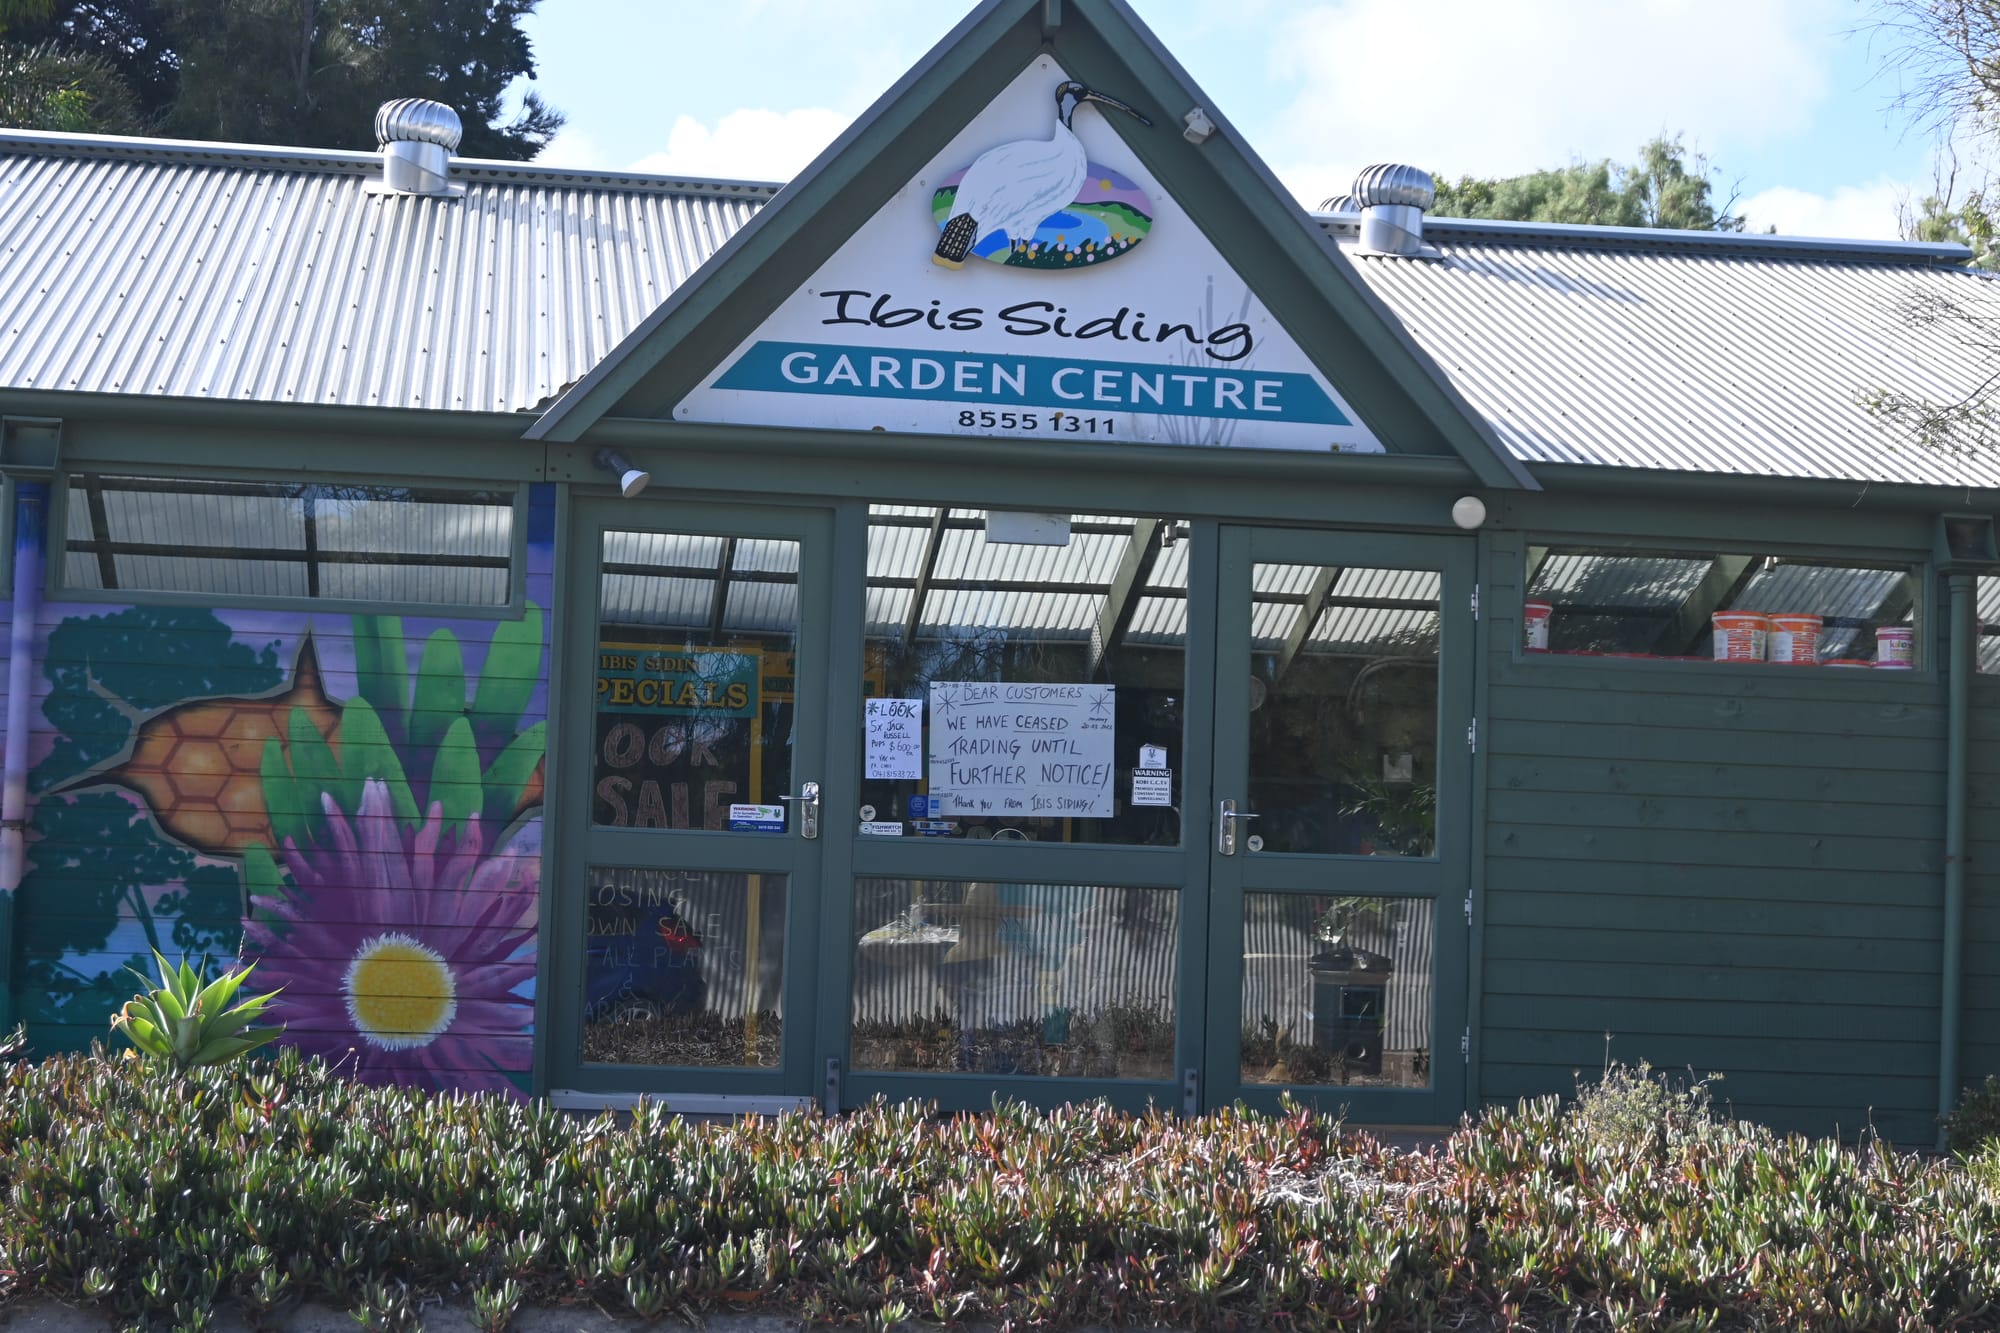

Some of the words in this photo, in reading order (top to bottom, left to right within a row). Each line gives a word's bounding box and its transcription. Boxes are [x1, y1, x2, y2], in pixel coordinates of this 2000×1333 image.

[819, 289, 984, 331] Ibis
[998, 299, 1255, 360] Siding
[779, 350, 1027, 397] GARDEN
[1050, 366, 1285, 413] CENTRE
[957, 409, 1039, 431] 8555
[1047, 411, 1116, 435] 1311
[600, 656, 638, 671] IBIS
[963, 686, 998, 702] DEAR
[1006, 686, 1084, 700] CUSTOMERS
[947, 715, 967, 730] WE
[976, 714, 1010, 729] HAVE
[1015, 714, 1069, 730] CEASED
[883, 731, 911, 739] RUSSELL
[948, 735, 1022, 760] TRADING
[1032, 739, 1083, 755] UNTIL
[950, 761, 1026, 785] FURTHER
[1041, 763, 1111, 788] NOTICE!
[1031, 793, 1054, 811] IBIS
[655, 913, 721, 938] SALE
[601, 947, 642, 968] ALL
